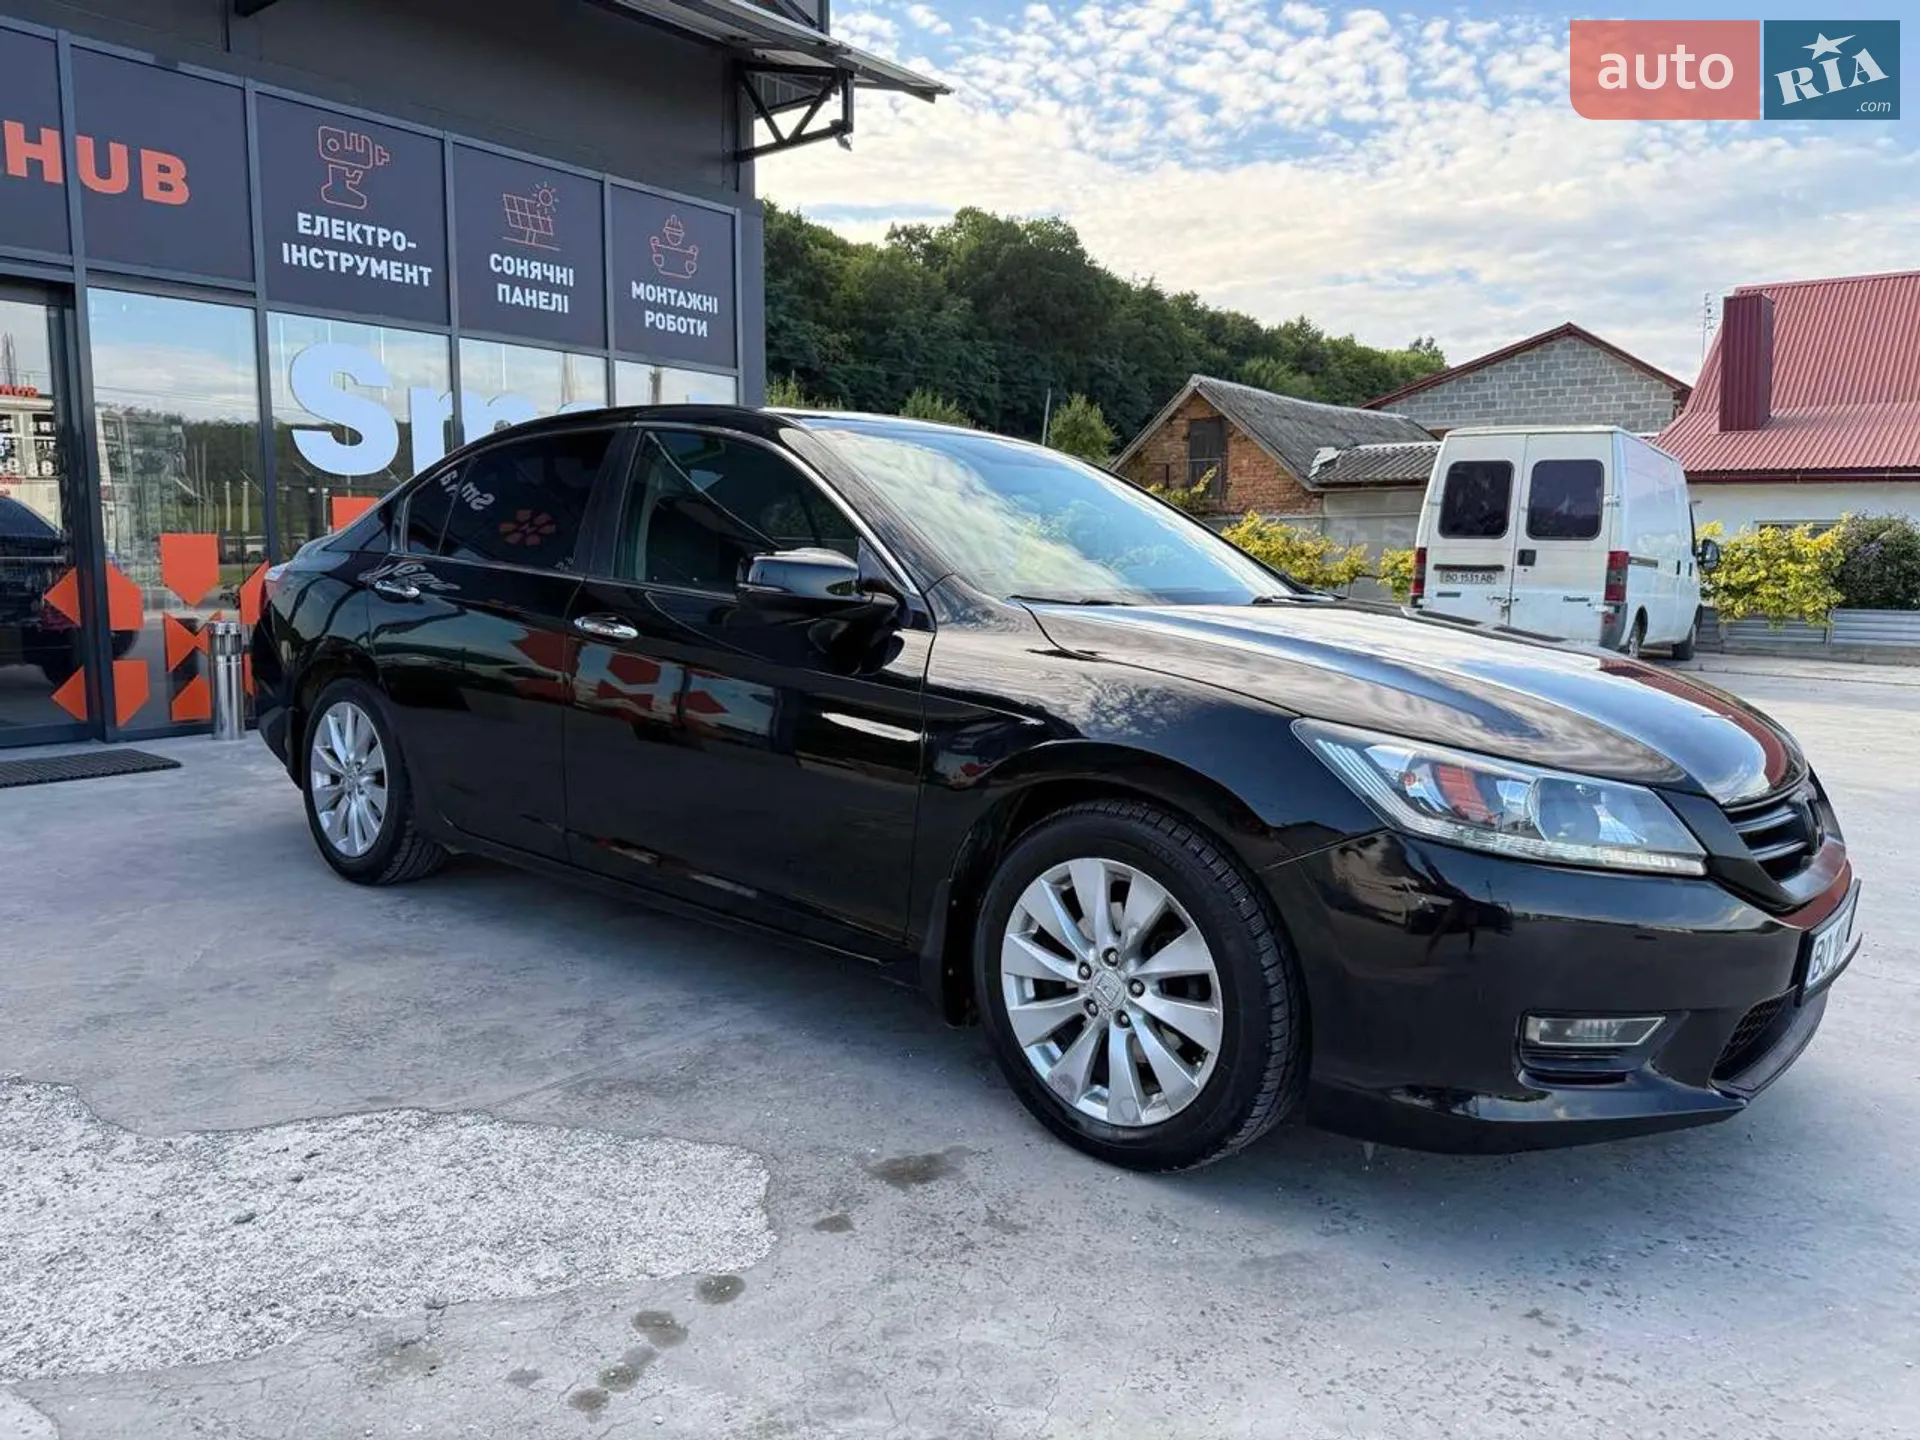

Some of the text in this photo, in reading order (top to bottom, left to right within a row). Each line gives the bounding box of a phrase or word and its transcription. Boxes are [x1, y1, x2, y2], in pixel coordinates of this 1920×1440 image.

[4, 120, 190, 205] HUB
[297, 212, 417, 252] ЕЛЕКТРО-
[282, 242, 433, 287] ІНСТРУМЕНТ
[489, 253, 575, 288] СОНЯЧНІ
[497, 283, 569, 314] ПАНЕЛІ
[631, 281, 718, 315] МОНТАЖНІ
[644, 309, 708, 338] РОБОТИ
